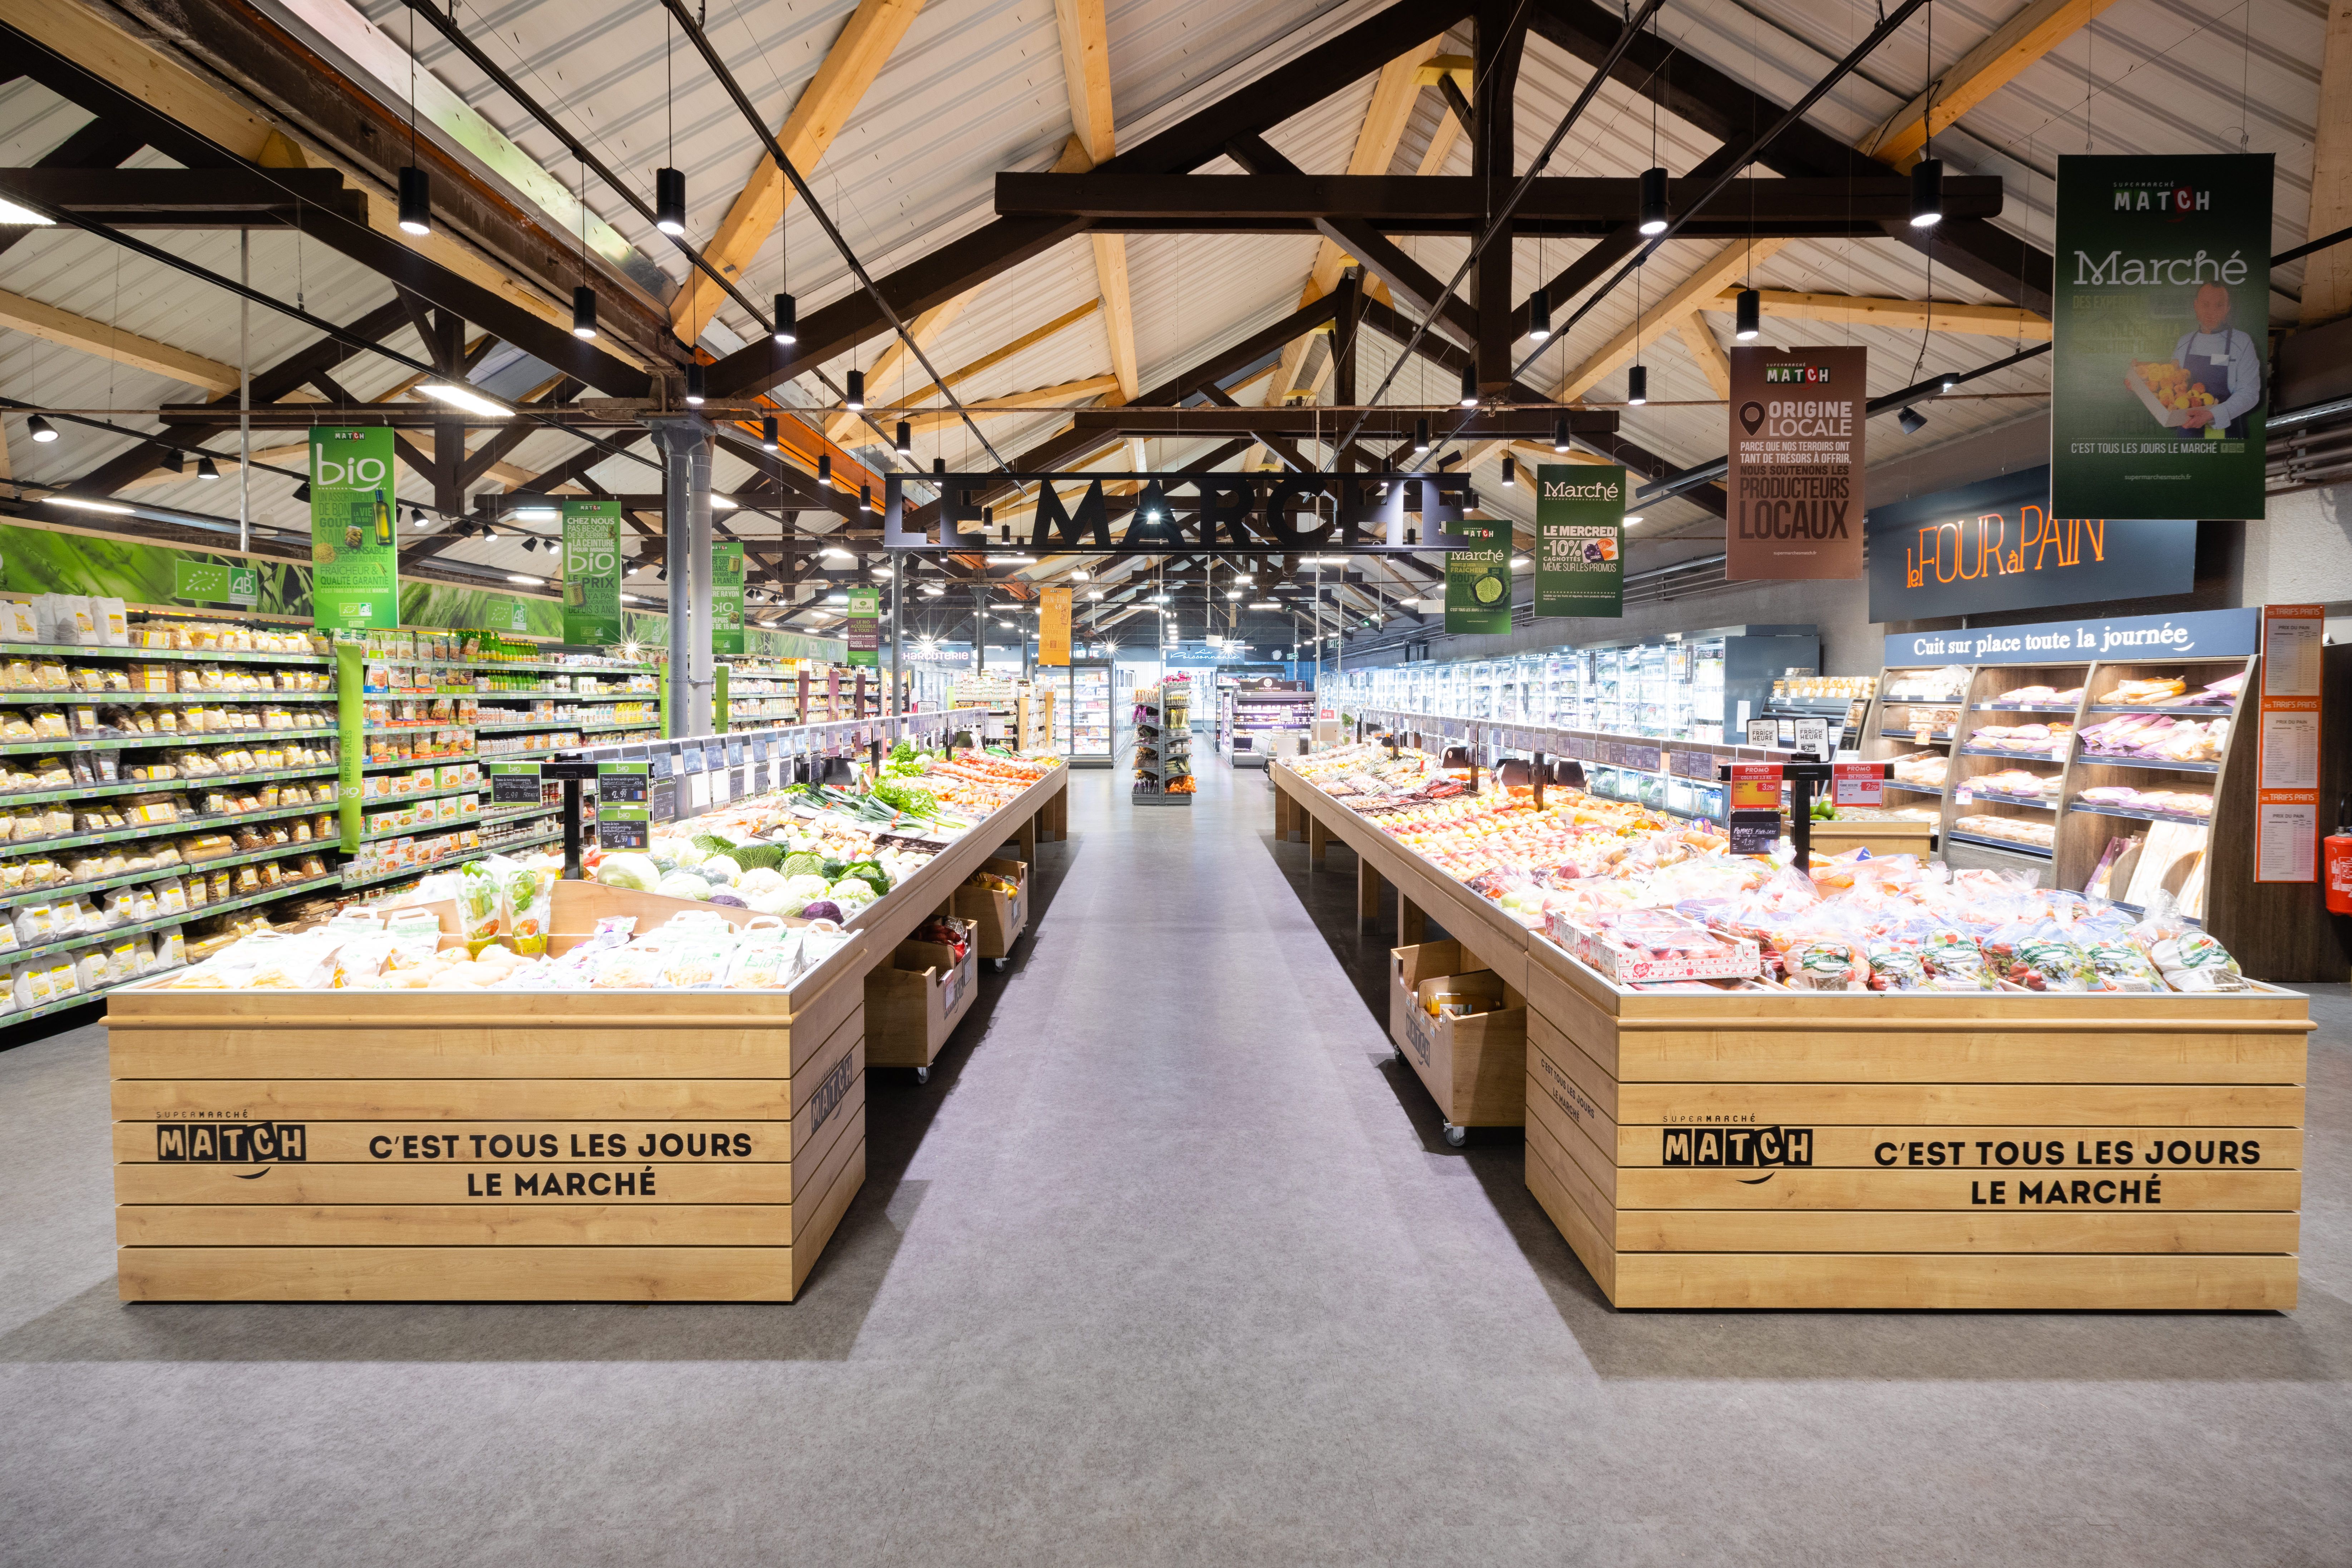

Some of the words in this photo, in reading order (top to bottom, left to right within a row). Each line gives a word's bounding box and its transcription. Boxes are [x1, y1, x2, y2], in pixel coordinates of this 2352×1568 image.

[2114, 189, 2210, 212] MATCH
[2073, 250, 2248, 285] Marché
[1766, 367, 1830, 383] MATCH
[1769, 401, 1852, 418] ORIGINE
[1770, 419, 1852, 437] LOCALE
[1740, 442, 1764, 451] PARCE
[1766, 442, 1780, 452] QUE
[1782, 442, 1797, 451] NOS
[1799, 442, 1833, 451] TERROIRS
[1835, 442, 1850, 451] ONT
[2071, 443, 2094, 453] C'EST
[2097, 443, 2119, 453] TOUS
[2121, 443, 2137, 453] LES
[2139, 443, 2165, 453] JOURS
[2168, 443, 2178, 453] LE
[2180, 441, 2217, 453] MARCHÉ
[316, 443, 386, 489] bio
[1740, 454, 1761, 463] TANT
[1763, 454, 1773, 463] DE
[1776, 452, 1811, 463] TRÉSORS
[1821, 453, 1851, 464] OFFRIR,
[1740, 466, 1766, 475] NOUS
[1770, 466, 1827, 475] SOUTENONS
[1831, 465, 1849, 474] LES
[1544, 482, 1618, 501] Marché
[1740, 477, 1849, 499] PRODUCTEURS
[319, 503, 331, 516] DE
[333, 503, 350, 515] BON
[886, 479, 987, 546] LE
[319, 513, 350, 528] GOÛT
[1739, 501, 1849, 539] LOCAUX
[1544, 526, 1558, 536] LE
[1559, 526, 1617, 537] MERCREDI
[1544, 540, 1581, 556] -10%
[1907, 548, 1918, 588] le
[1918, 513, 2006, 586] FOUR
[2018, 505, 2104, 572] PAIN
[567, 542, 615, 573] bio
[1451, 549, 1503, 563] Marché
[1543, 561, 1562, 571] MÊME
[1563, 563, 1576, 571] SUR
[1576, 563, 1588, 572] LES
[1589, 563, 1616, 572] PROMOS
[232, 576, 252, 594] AB
[321, 575, 350, 585] QUALITÉ
[352, 576, 389, 585] GARANTIE
[582, 577, 615, 588] PRIX
[1043, 595, 1068, 603] BIEN-ÊTRE
[514, 609, 524, 621] AB
[1914, 638, 1944, 655] Cuit
[1948, 641, 1971, 654] sur
[1975, 634, 2021, 657] place
[2025, 632, 2070, 651] toute
[2077, 628, 2096, 647] la
[2101, 622, 2188, 652] journée
[343, 730, 352, 753] SALÉS
[509, 764, 521, 773] bio
[617, 764, 629, 772] bio
[618, 810, 630, 819] bio
[812, 1052, 852, 1135] MATCH
[1541, 1059, 1553, 1076] C'EST
[1554, 1071, 1565, 1090] TOUS
[1577, 1095, 1594, 1119] JOURS
[1553, 1087, 1558, 1099] LE
[1559, 1094, 1579, 1122] MARCHÉ
[157, 1109, 248, 1119] SUPERMARCHÉ
[1663, 1114, 1756, 1123] SUPERMARCHÉ
[157, 1123, 306, 1162] MATCH
[369, 1133, 459, 1158] C'EST
[473, 1134, 559, 1158] TOUS
[571, 1133, 627, 1157] LES
[638, 1133, 753, 1157] JOURS
[1663, 1127, 1813, 1167] MATCH
[1874, 1141, 1965, 1166] C'EST
[1976, 1141, 2065, 1166] TOUS
[2076, 1141, 2135, 1165] LES
[2146, 1140, 2261, 1165] JOURS
[467, 1173, 501, 1197] LE
[515, 1165, 656, 1197] MARCHÉ
[1972, 1180, 2006, 1205] LE
[2019, 1173, 2162, 1205] MARCHÉ
